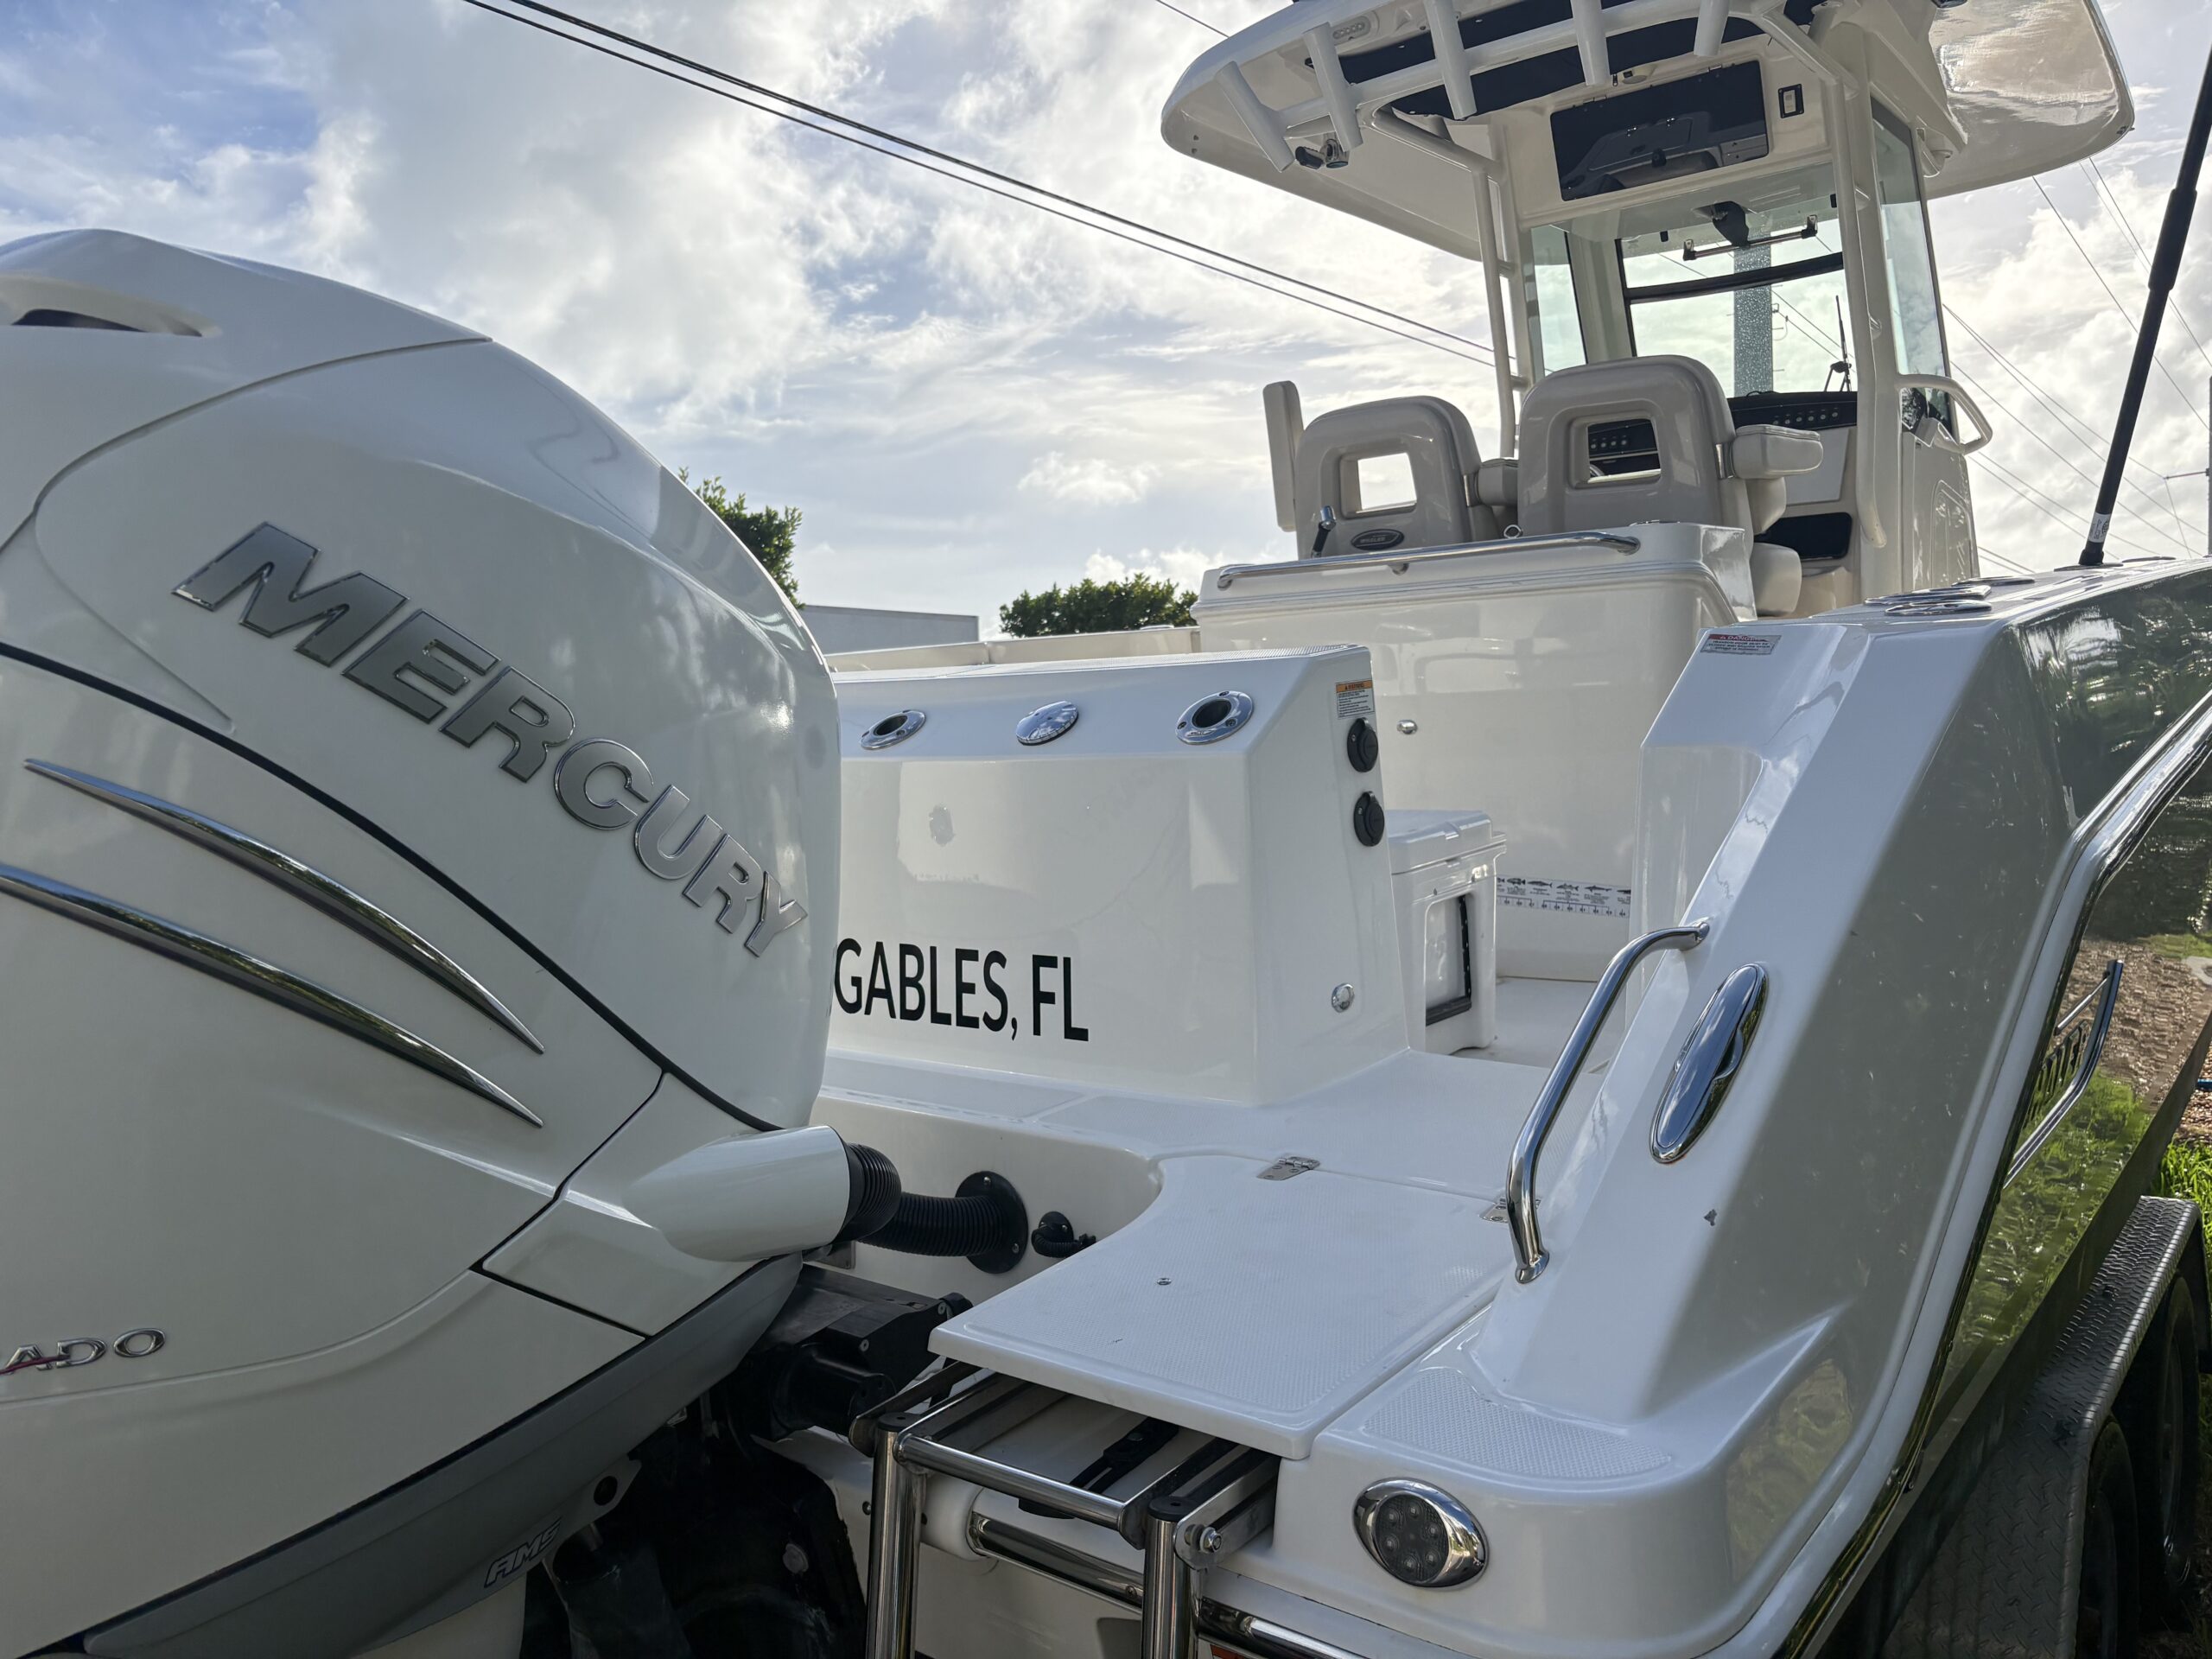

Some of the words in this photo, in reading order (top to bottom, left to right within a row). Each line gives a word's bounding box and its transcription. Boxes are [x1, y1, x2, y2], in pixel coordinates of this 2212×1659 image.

[171, 521, 808, 957] MERCURY
[834, 938, 1018, 1041] GABLES,
[1032, 954, 1089, 1042] FL
[484, 1516, 563, 1588] AMS
